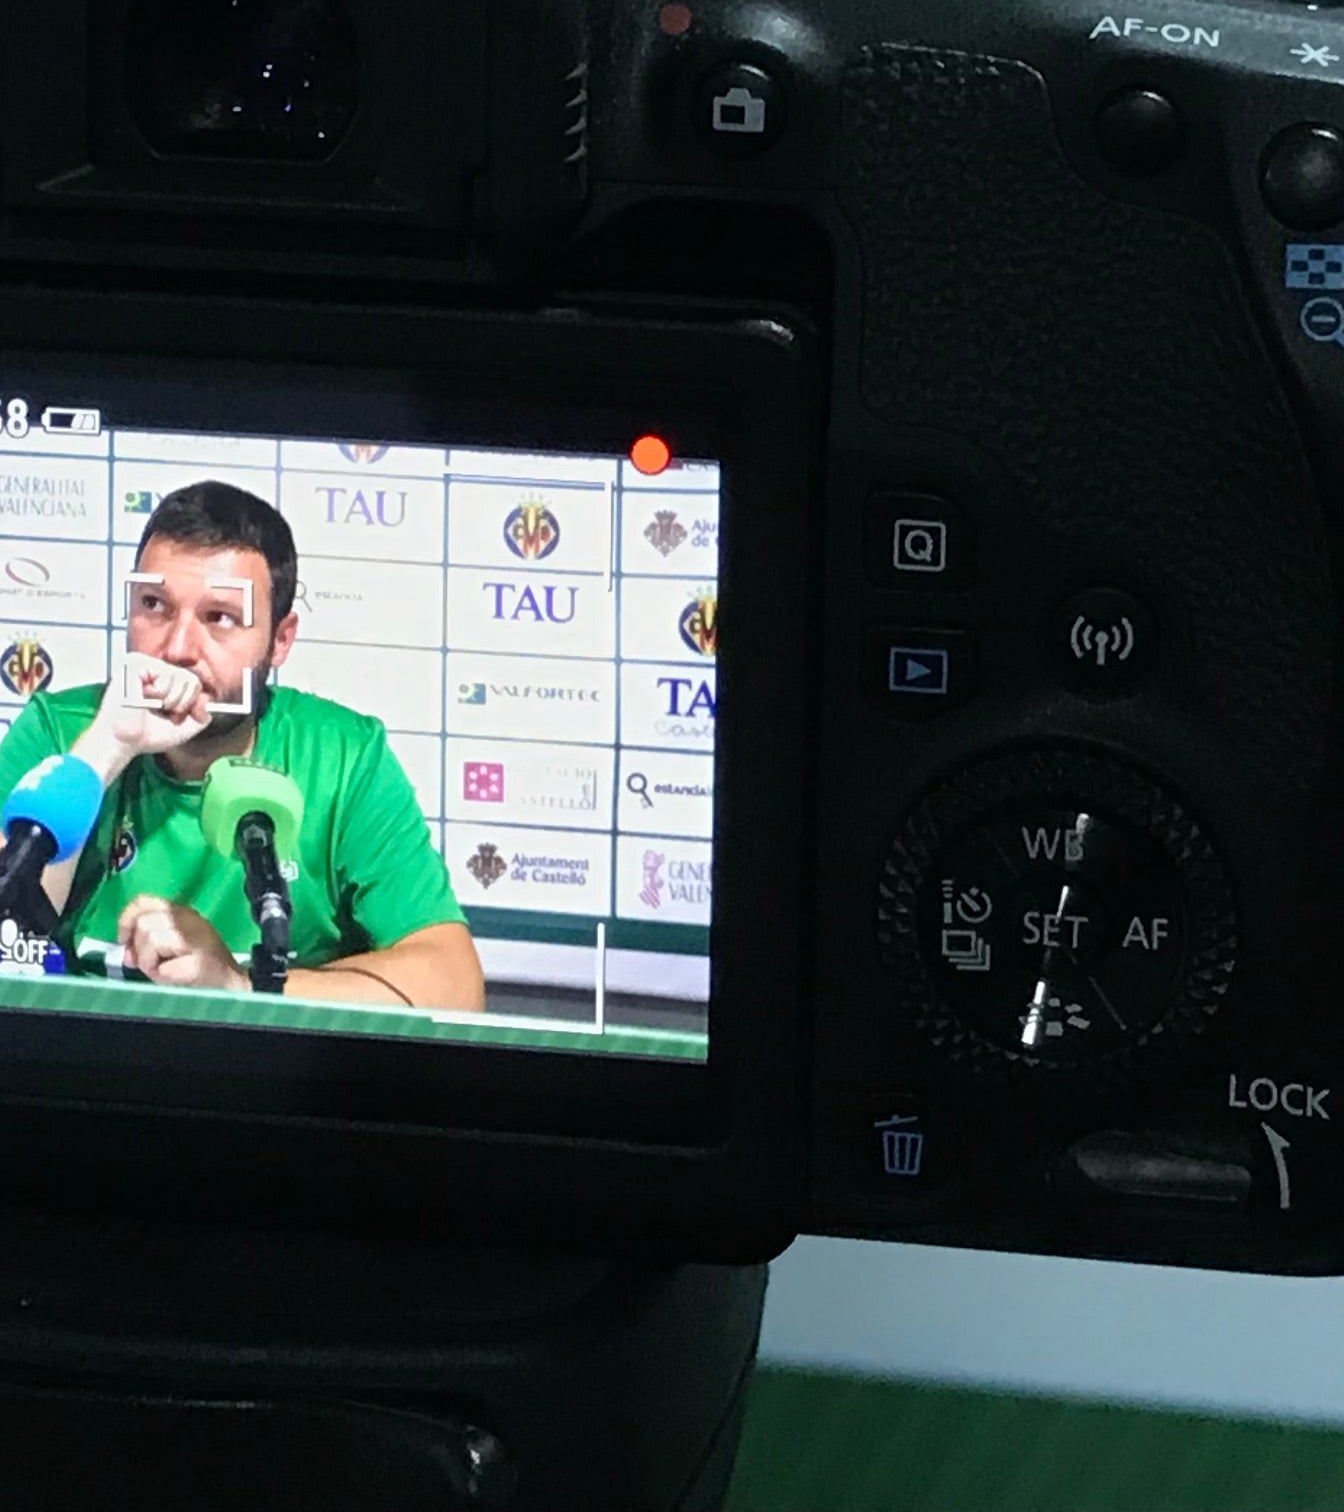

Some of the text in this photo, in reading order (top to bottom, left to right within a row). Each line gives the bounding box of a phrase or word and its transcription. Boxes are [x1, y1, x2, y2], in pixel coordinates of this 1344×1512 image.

[1089, 15, 1221, 49] AF-ON
[315, 486, 408, 528] TAU
[482, 582, 581, 624] TAU
[1022, 826, 1085, 863] WB
[510, 852, 591, 874] Ajuntament
[510, 868, 588, 888] de Castelló
[1022, 912, 1089, 949] SET
[1122, 915, 1169, 951] AF
[13, 938, 49, 965] OFF
[1228, 1072, 1331, 1121] LOCK
